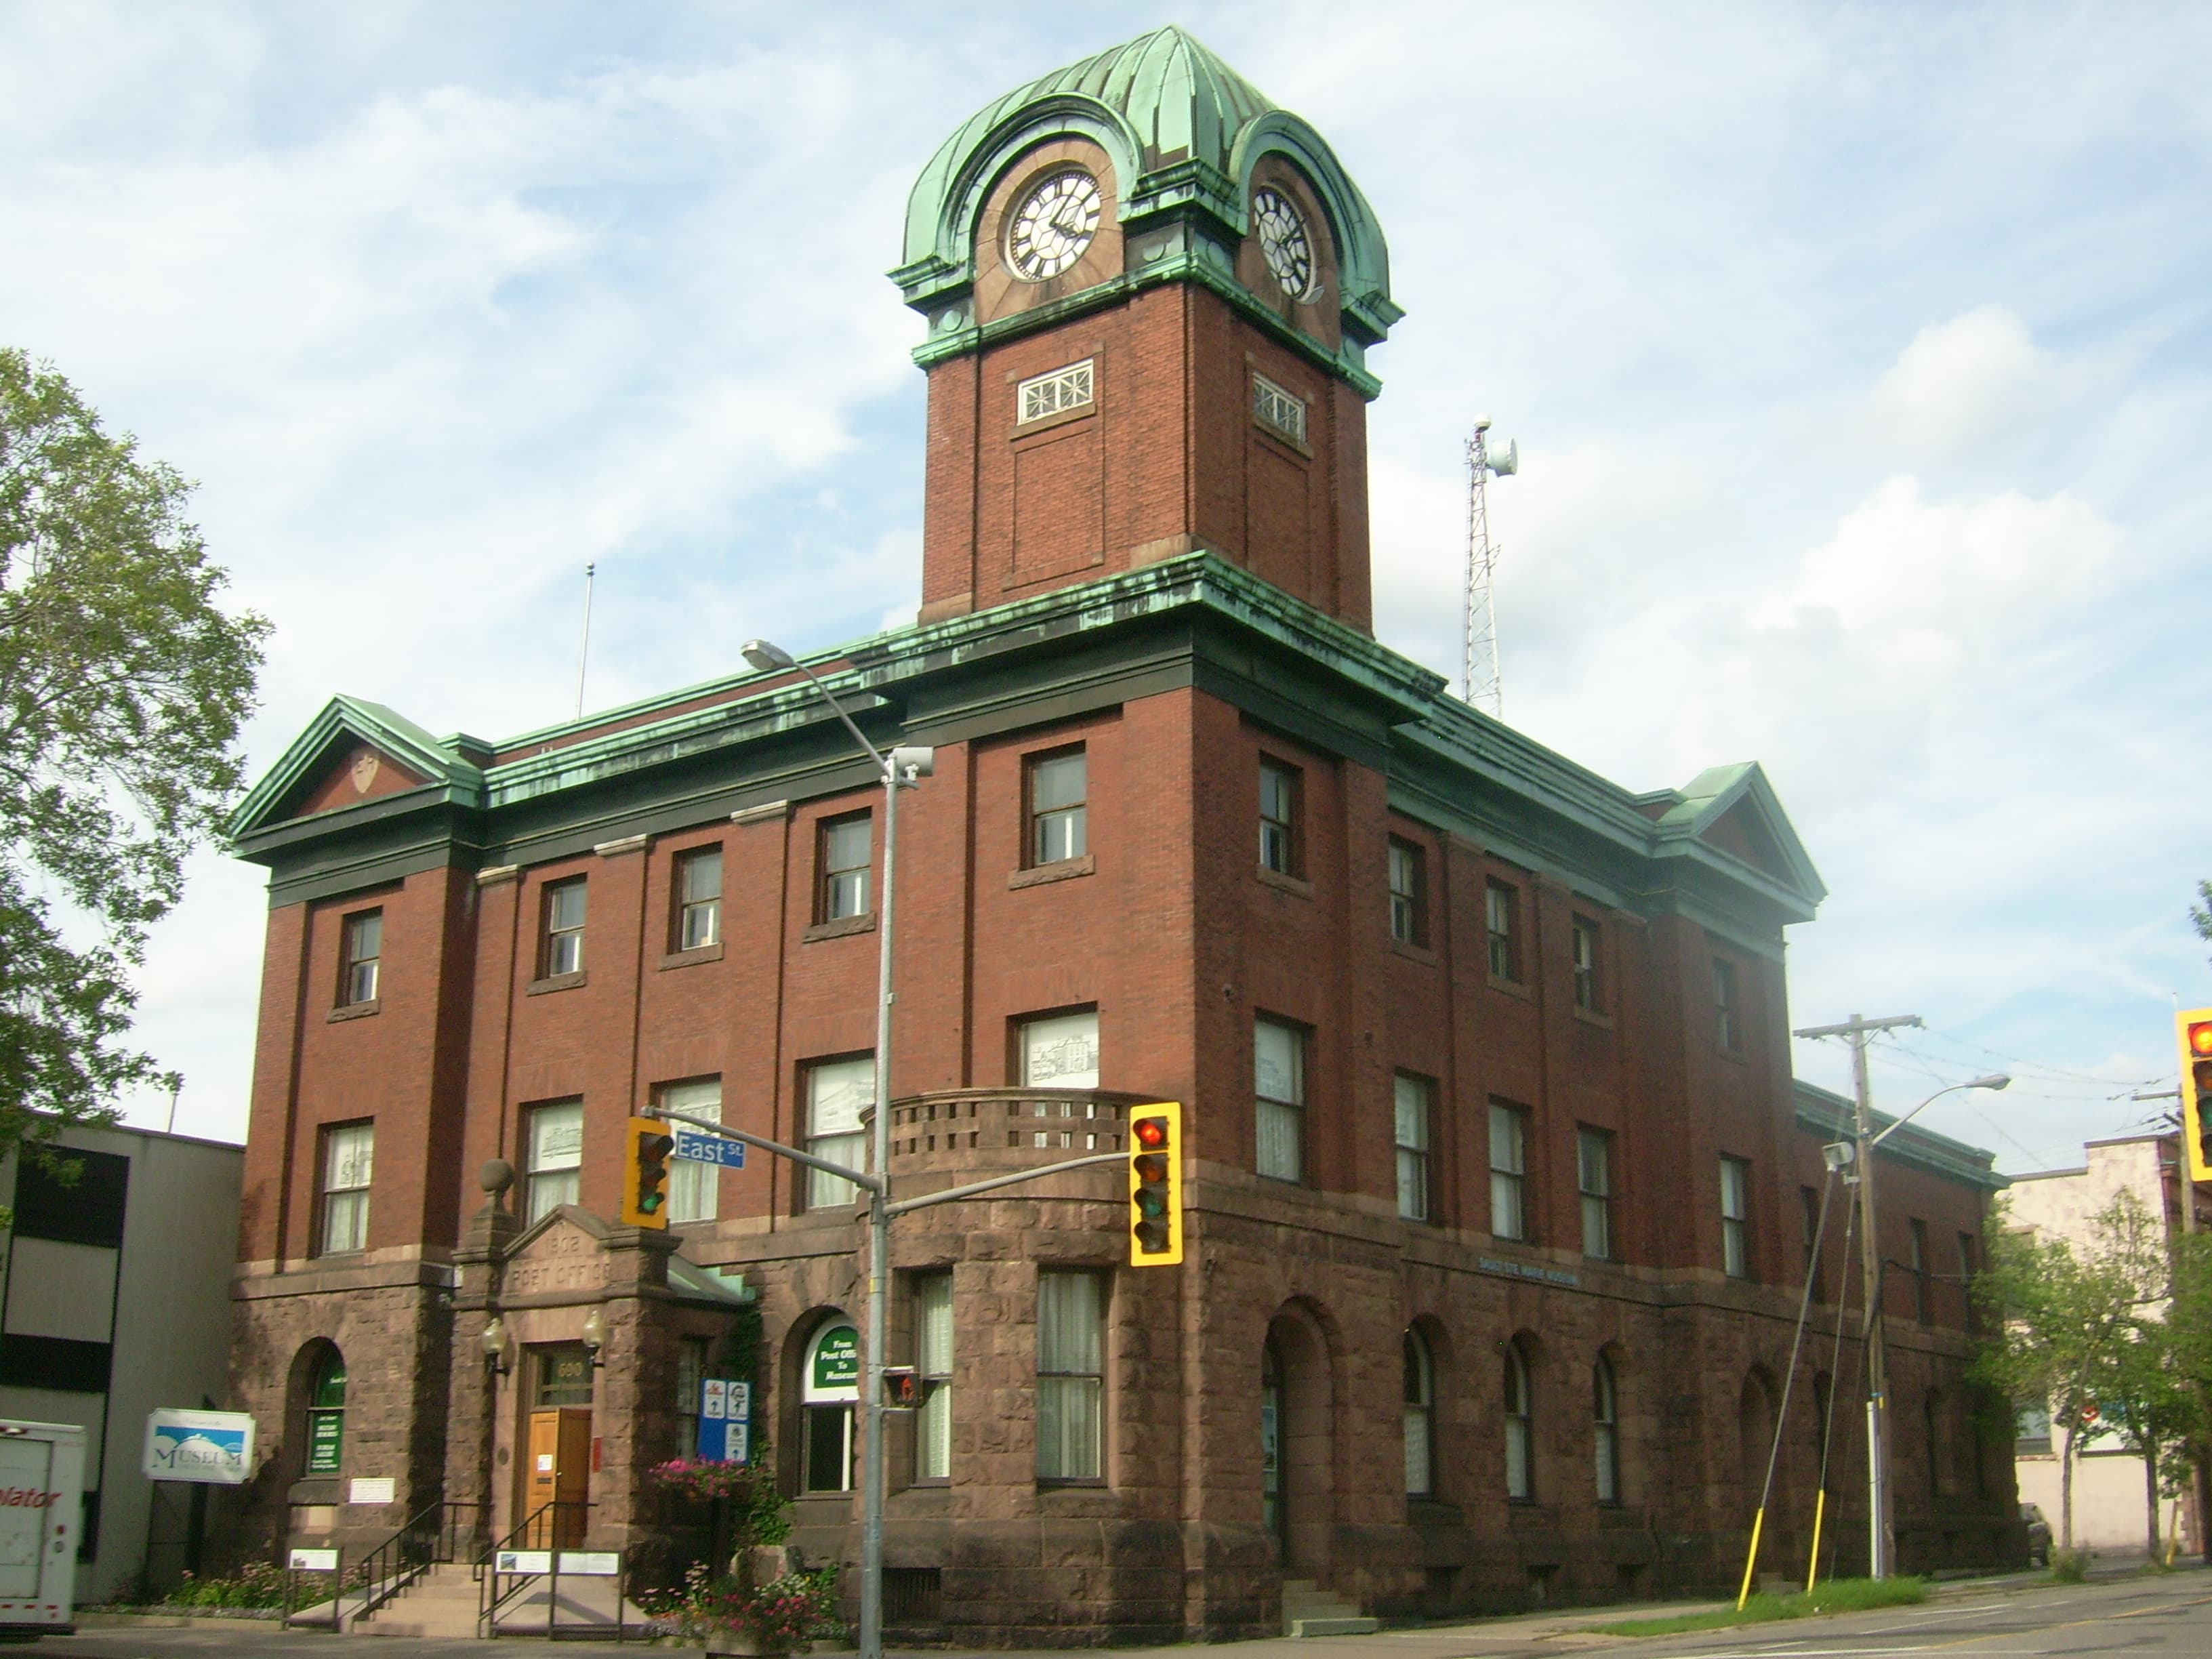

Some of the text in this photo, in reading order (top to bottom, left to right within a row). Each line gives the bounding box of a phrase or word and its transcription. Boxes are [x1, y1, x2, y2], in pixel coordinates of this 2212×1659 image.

[678, 1134, 724, 1163] East
[546, 1236, 579, 1253] 1902
[512, 1267, 550, 1287] POST
[833, 1340, 853, 1349] From
[820, 1349, 857, 1361] Post Offi
[837, 1360, 848, 1370] To
